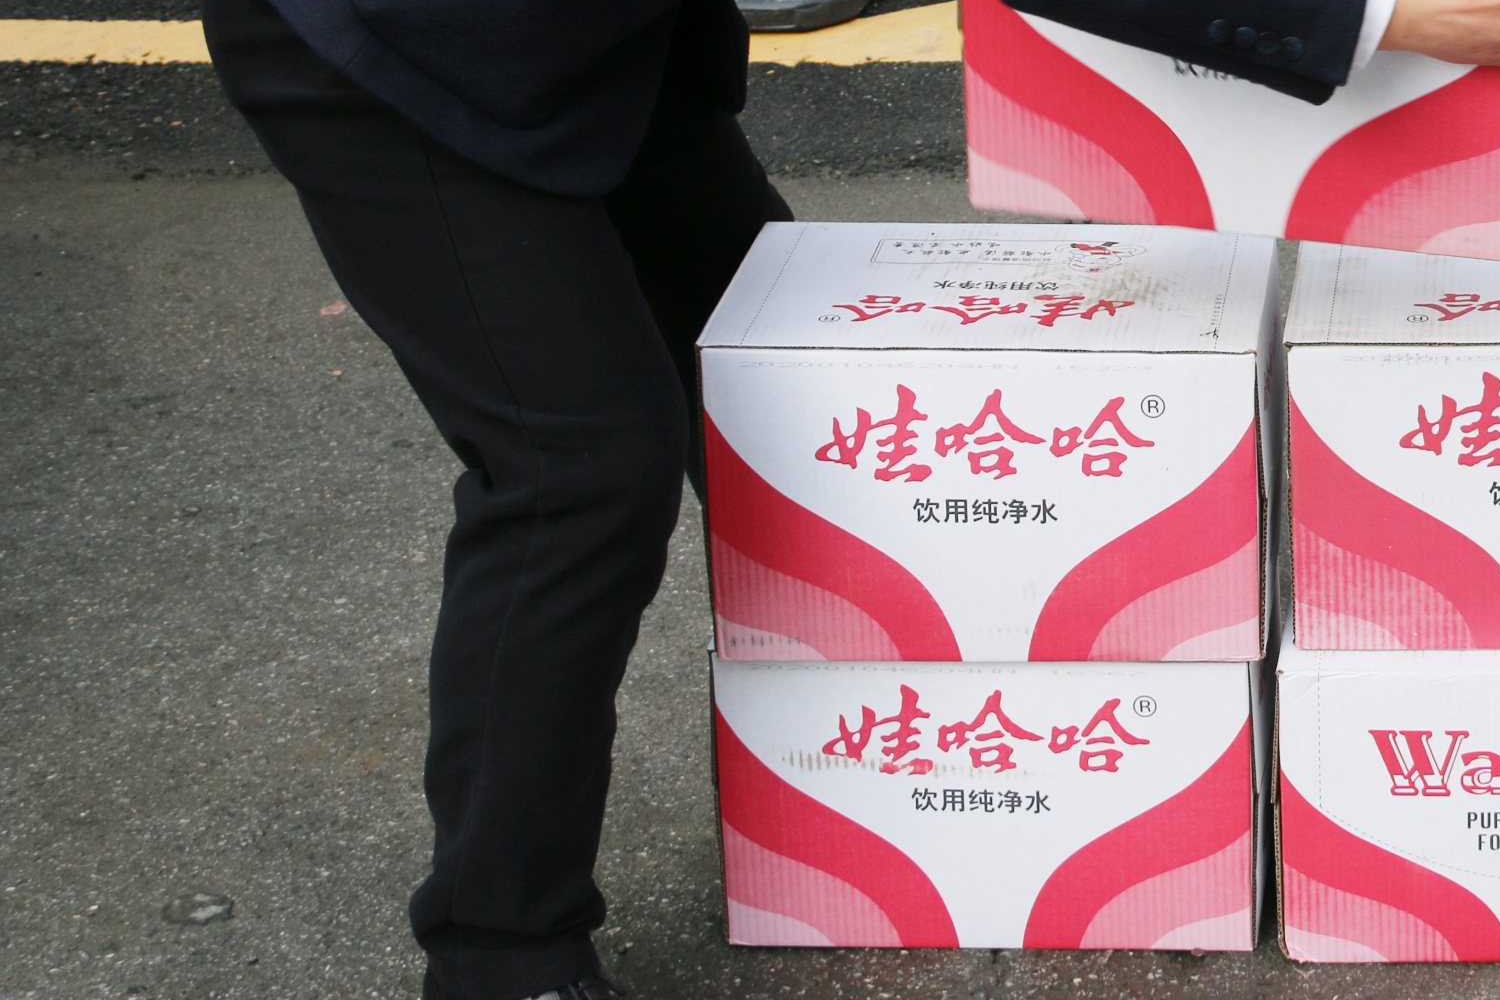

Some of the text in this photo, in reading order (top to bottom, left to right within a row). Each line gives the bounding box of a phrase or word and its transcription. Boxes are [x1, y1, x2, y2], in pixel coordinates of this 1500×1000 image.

[933, 279, 1060, 291] 饮用纯净水
[832, 293, 1136, 328] 娃哈哈
[815, 384, 1156, 482] 娃哈哈
[912, 498, 1058, 524] 饮用纯净水
[822, 683, 1151, 776] 娃哈哈
[911, 787, 1052, 814] 饮用纯净水
